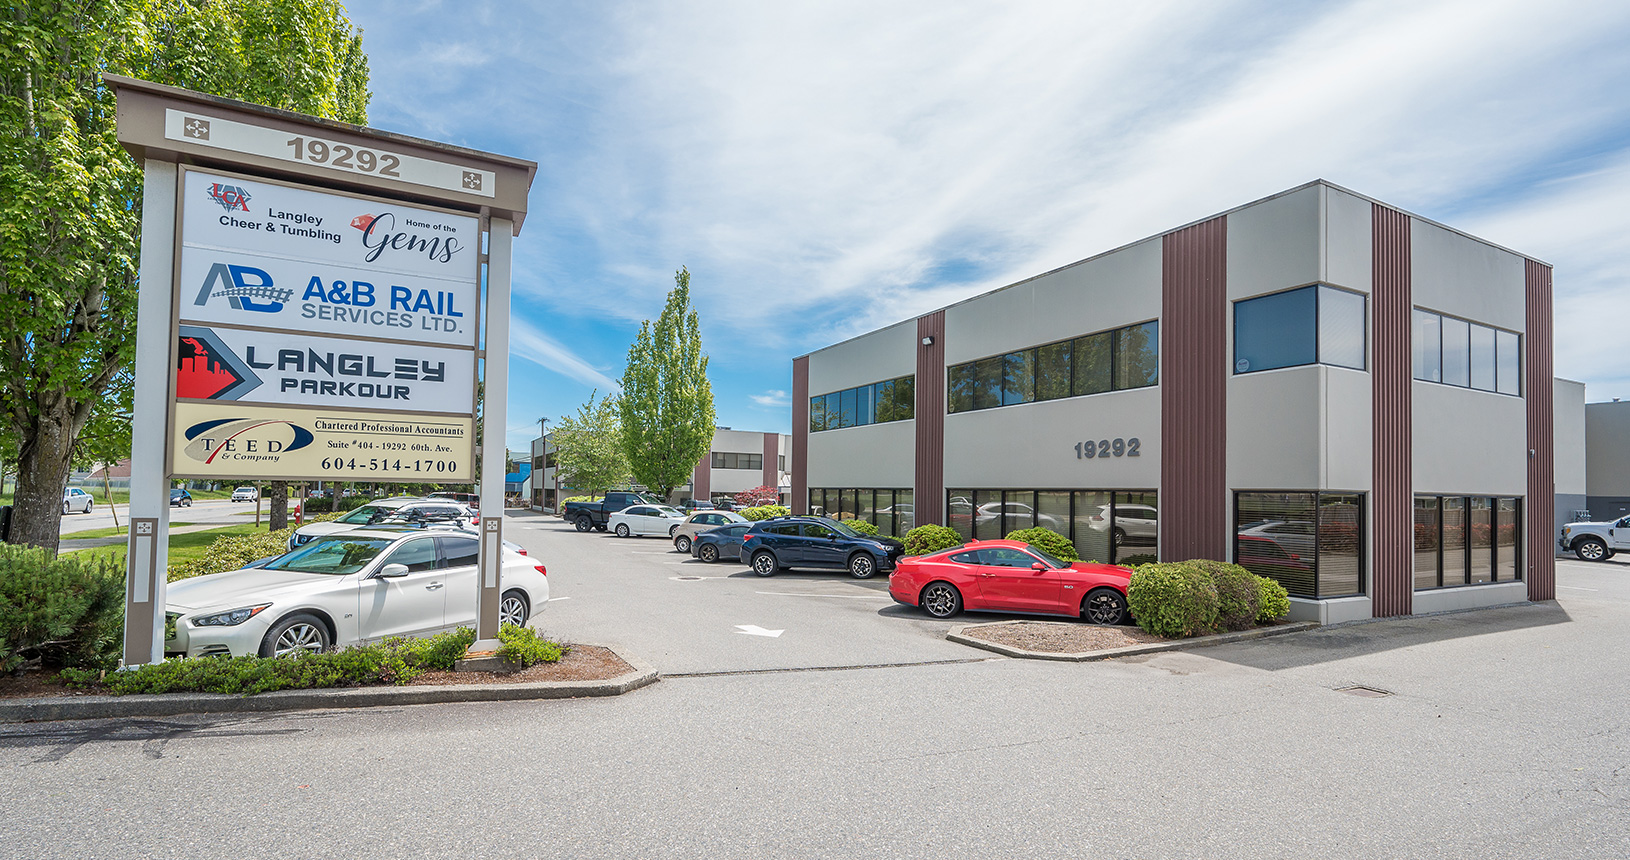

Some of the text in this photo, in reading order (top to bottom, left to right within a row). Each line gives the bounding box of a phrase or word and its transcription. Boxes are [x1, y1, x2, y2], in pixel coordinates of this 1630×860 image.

[287, 137, 400, 177] 19292
[211, 182, 250, 212] LCA
[268, 208, 323, 226] Langley
[406, 219, 430, 229] Home
[219, 215, 341, 243] Cheer & Tumbling
[362, 212, 464, 263] Gems
[302, 276, 464, 317] A&B RAIL
[301, 303, 463, 333] SERVICES LTD.
[246, 346, 445, 382] LANGLEY
[280, 377, 410, 400] PARKOUR
[315, 420, 464, 436] Chartered Professional Accountants
[201, 438, 283, 453] TEED
[327, 440, 349, 449] Suite
[352, 440, 373, 450] #404
[382, 442, 407, 450] 19292
[411, 444, 432, 452] 60th.
[435, 444, 453, 453] Ave.
[1074, 437, 1141, 460] 19292
[233, 453, 280, 462] Company
[321, 457, 457, 473] 604-514-1700
